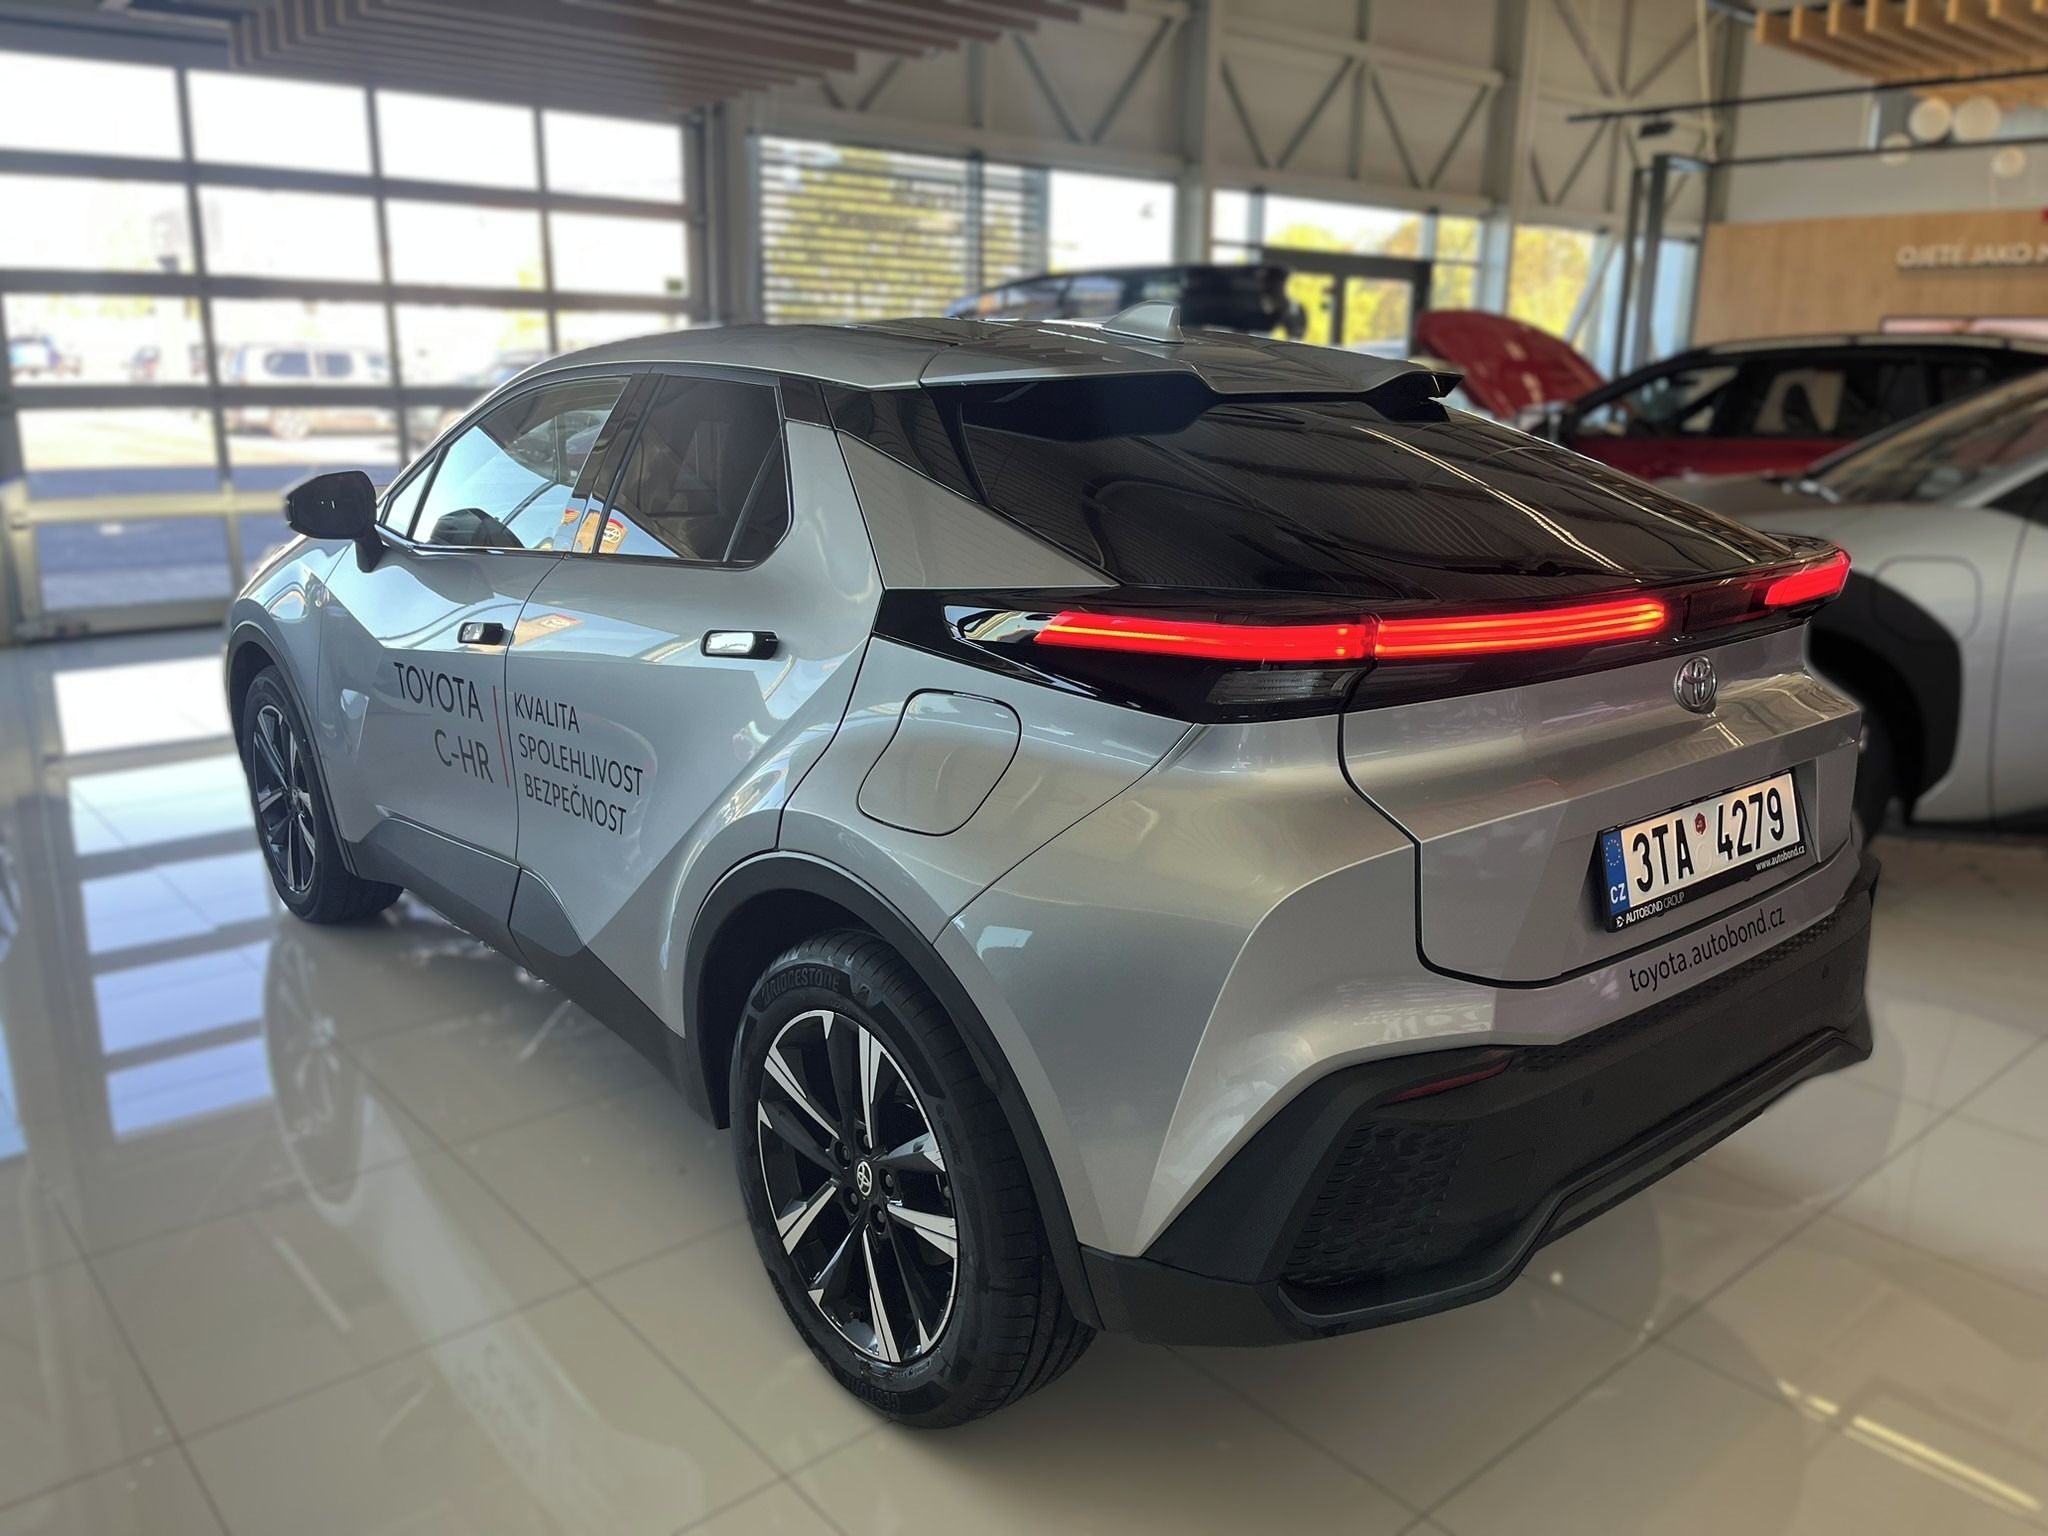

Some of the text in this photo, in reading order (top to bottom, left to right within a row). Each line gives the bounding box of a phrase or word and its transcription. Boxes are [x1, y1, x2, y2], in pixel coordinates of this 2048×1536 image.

[393, 662, 484, 722] TOYOTA
[513, 692, 580, 733] KVALITA
[434, 729, 494, 783] C-HR
[518, 733, 643, 796] SPOLEHLIVOST
[524, 773, 626, 835] BEZPEČNOST
[1632, 787, 1785, 892] 3TA 4279
[1755, 845, 1806, 871] www.autobond.cz
[1610, 883, 1627, 904] CZ
[1625, 891, 1686, 924] AUTOBOND GROUP
[1629, 906, 1786, 992] toyota.autobond.cz
